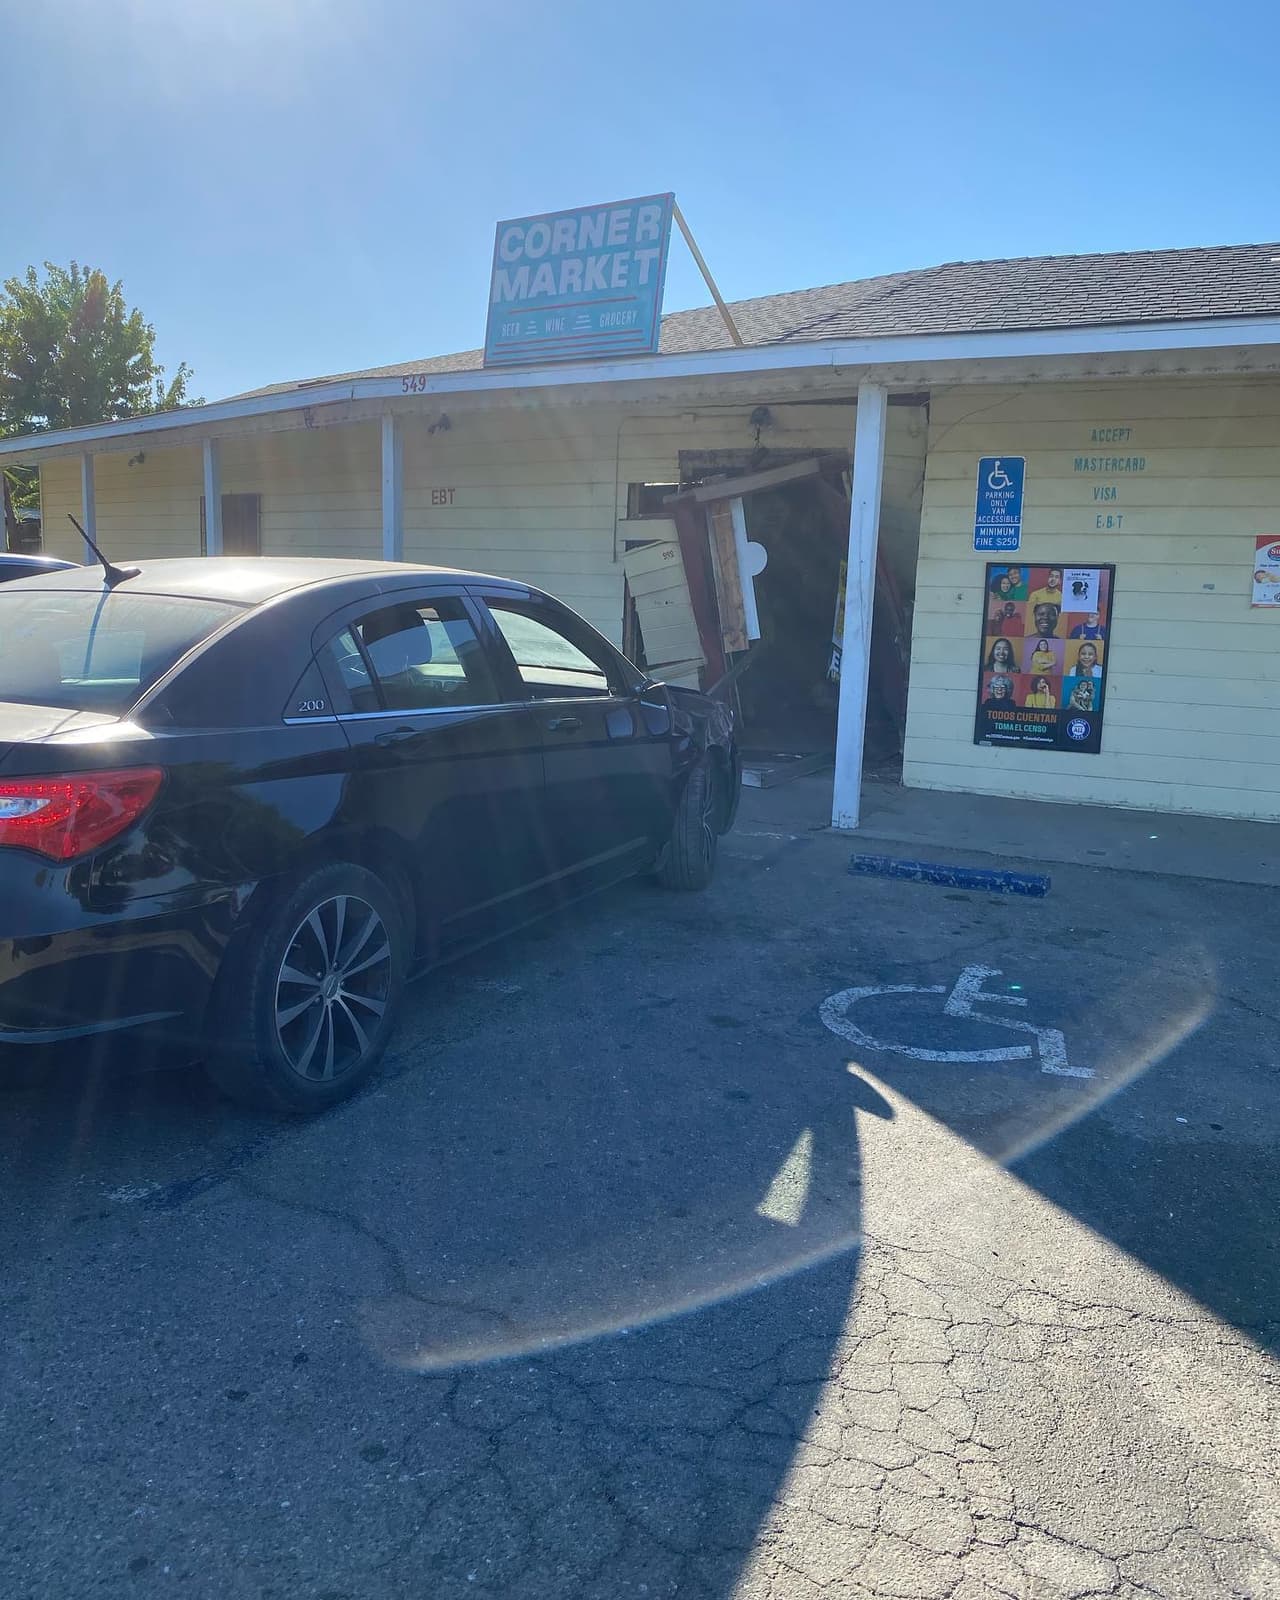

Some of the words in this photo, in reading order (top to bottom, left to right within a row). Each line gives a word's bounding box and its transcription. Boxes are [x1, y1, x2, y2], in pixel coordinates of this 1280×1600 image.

[501, 205, 662, 262] CORNER
[493, 248, 660, 303] MARKET
[502, 322, 520, 336] BEER
[545, 317, 565, 332] WINE
[600, 310, 637, 328] GROCERY
[402, 375, 426, 392] 549
[1091, 428, 1132, 442] ACCEPT
[1074, 457, 1146, 472] MASTERCARD
[431, 488, 455, 505] EBT
[985, 491, 1015, 499] PARKING
[1094, 487, 1117, 501] VISA
[990, 499, 1009, 507] ONLY
[991, 507, 1006, 515] VAN
[977, 515, 1020, 523] ACCESSIBLE
[979, 528, 1015, 536] MINIMUM
[975, 537, 994, 546] FINE
[996, 537, 1018, 546] $250
[299, 700, 325, 712] 200
[986, 710, 1016, 720] TODOS
[1016, 712, 1057, 723] CUENTAN
[994, 722, 1014, 731] TOMA
[1014, 724, 1023, 732] EL
[1023, 724, 1047, 733] CENSO
